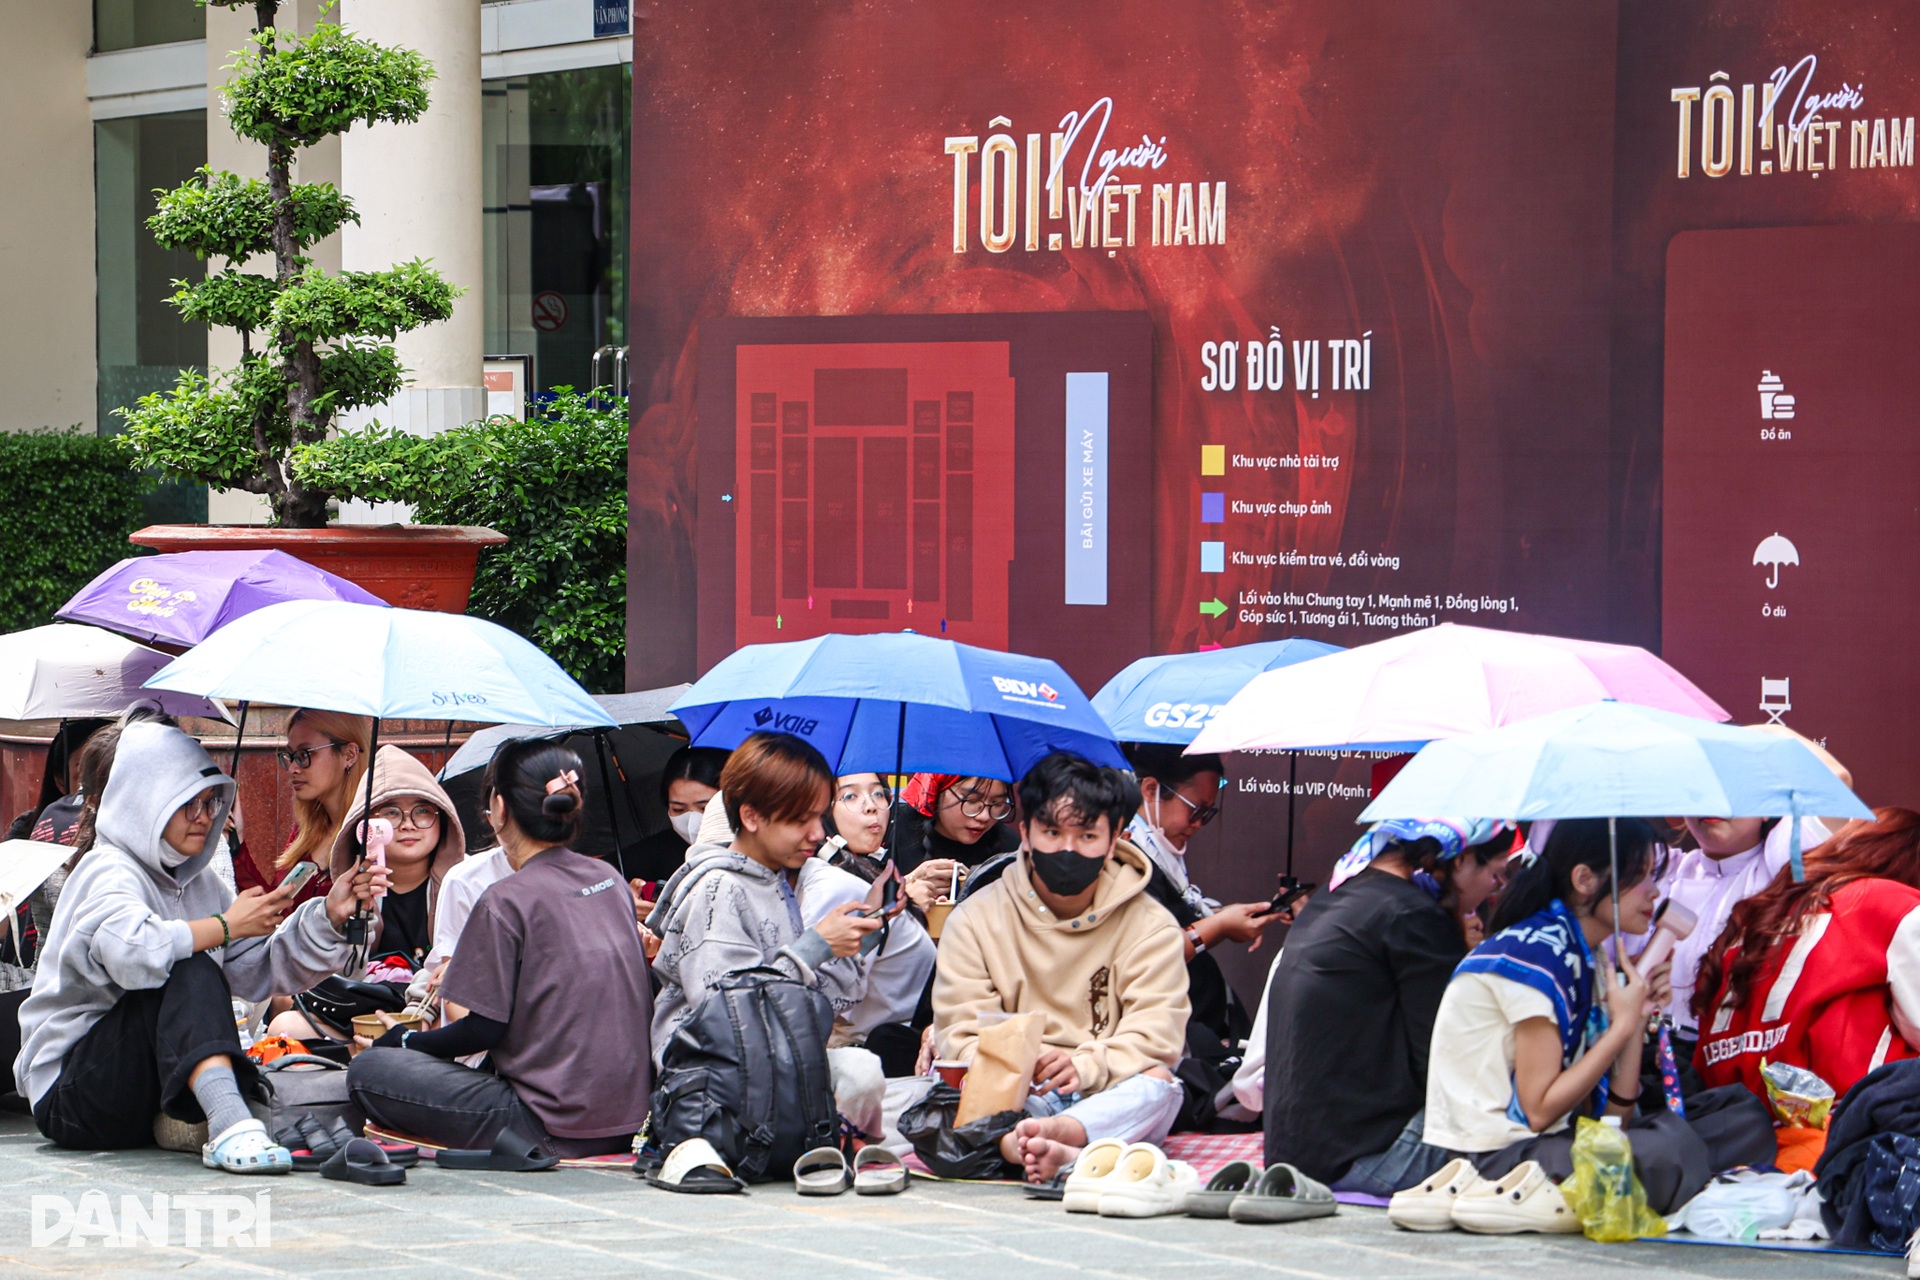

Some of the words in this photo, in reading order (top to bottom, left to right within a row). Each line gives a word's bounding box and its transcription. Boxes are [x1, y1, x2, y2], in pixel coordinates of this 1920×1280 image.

[1777, 115, 1842, 179] VIỆT
[1850, 117, 1915, 170] NAM
[1067, 175, 1142, 258] VIỆT
[1152, 181, 1227, 247] NAM
[1200, 340, 1240, 392] SƠ
[1246, 325, 1284, 391] ĐỒ
[1292, 339, 1320, 399] VỊ
[1328, 330, 1373, 391] TRÍ
[1778, 428, 1792, 440] ăn
[1080, 429, 1093, 463] MÁY
[1232, 454, 1253, 468] Khu
[1256, 454, 1277, 471] vực
[1279, 454, 1301, 468] nhà
[1303, 454, 1319, 468] tài
[1321, 455, 1340, 471] trợ
[1083, 466, 1093, 487] XE
[1231, 500, 1253, 514] Khu
[1255, 500, 1277, 517] vực
[1279, 501, 1308, 518] chụp
[1310, 499, 1332, 514] ảnh
[1081, 522, 1093, 549] BÃI
[1232, 551, 1253, 565] Khu
[1256, 552, 1277, 568] vực
[1279, 549, 1307, 566] kiểm
[1309, 553, 1326, 566] tra
[1328, 553, 1346, 568] vé,
[1348, 550, 1368, 567] đổi
[1370, 553, 1400, 570] vòng
[1239, 588, 1257, 605] Lối
[1260, 591, 1281, 605] vào
[1283, 592, 1304, 606] khu
[1306, 592, 1344, 610] Chung
[1345, 594, 1365, 610] tay
[1367, 594, 1376, 609] 1,
[1379, 594, 1411, 611] Mạnh
[1413, 595, 1432, 609] mẽ
[1434, 595, 1443, 610] 1,
[1480, 595, 1508, 613] lòng
[1510, 596, 1519, 612] 1,
[1761, 602, 1771, 617] Ô
[1239, 608, 1264, 626] Góp
[1265, 609, 1286, 624] sức
[1288, 610, 1297, 625] 1,
[1300, 610, 1335, 628] Tương
[1337, 611, 1349, 625] ái
[1350, 612, 1360, 627] 1,
[1362, 612, 1399, 629] Tương
[1401, 612, 1429, 627] thân
[992, 675, 1038, 698] BIDV
[1239, 776, 1257, 793] Lối
[1258, 779, 1280, 794] vào
[1305, 782, 1326, 796] VIP
[1327, 782, 1365, 800] (Mạnh
